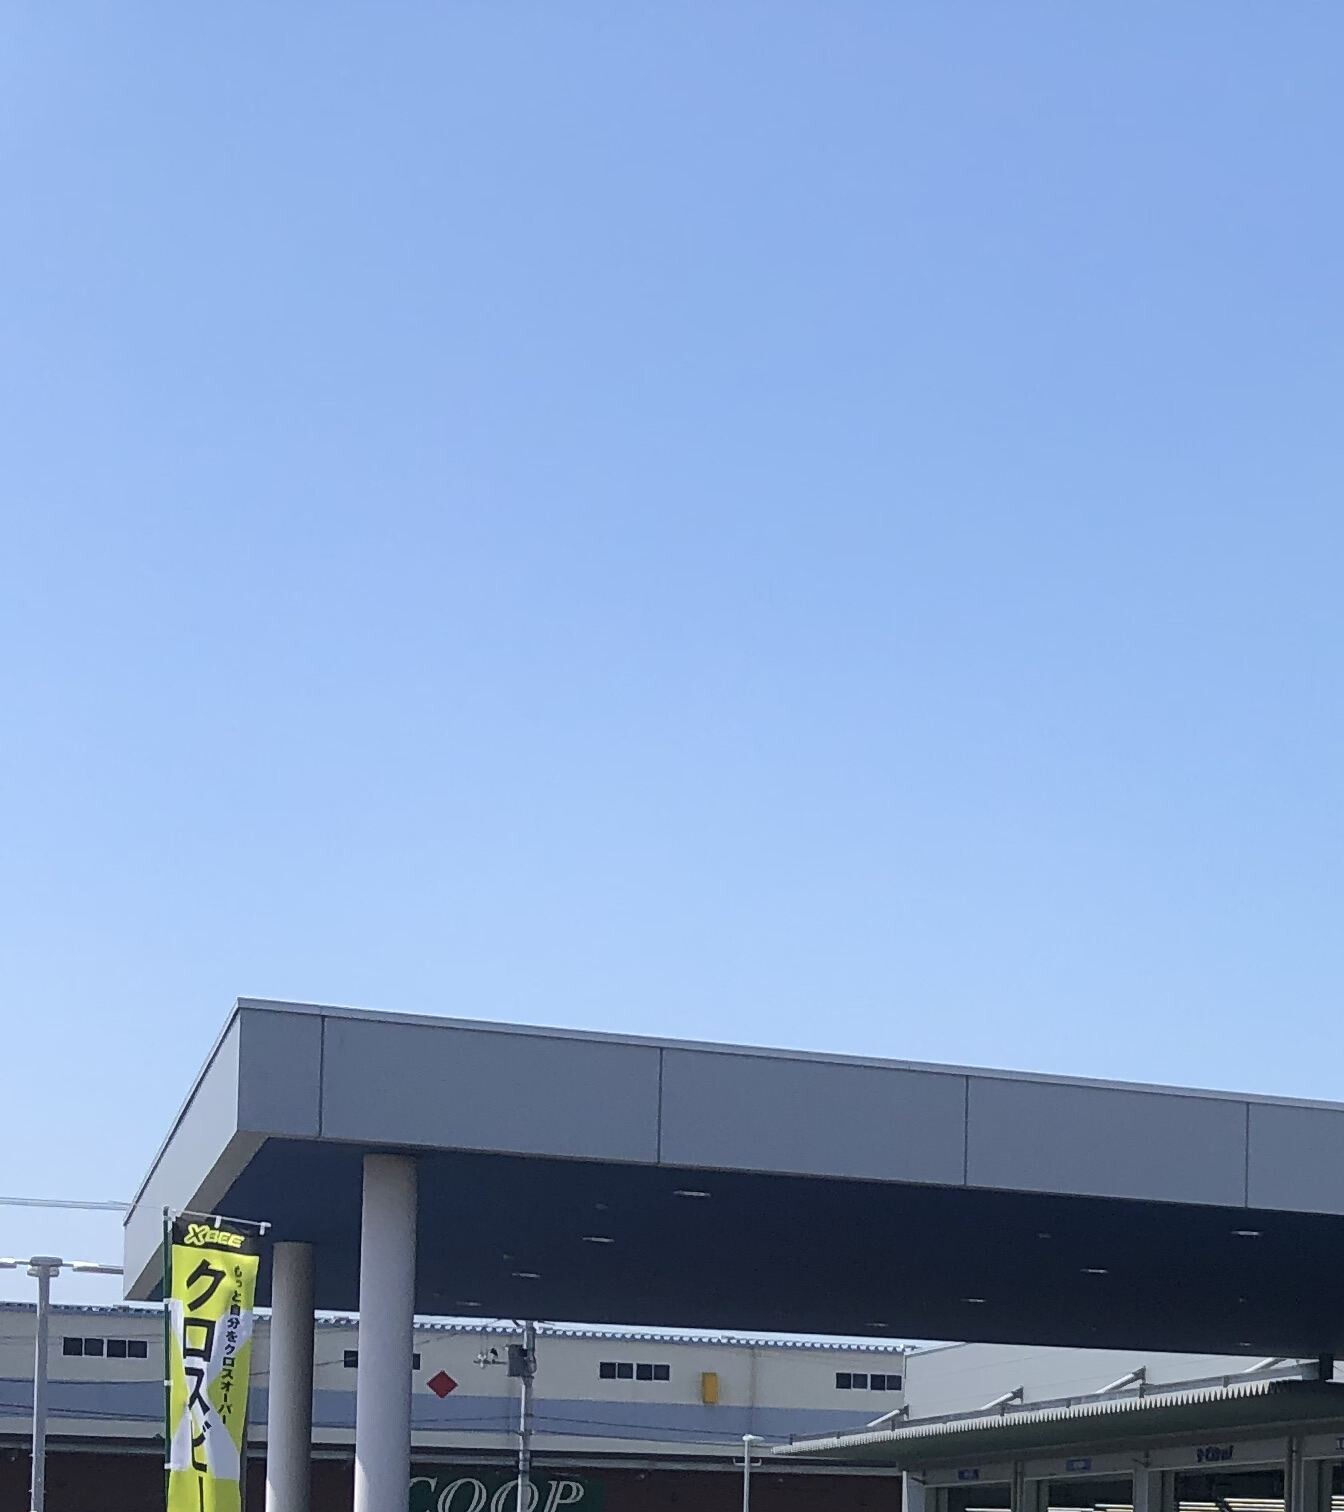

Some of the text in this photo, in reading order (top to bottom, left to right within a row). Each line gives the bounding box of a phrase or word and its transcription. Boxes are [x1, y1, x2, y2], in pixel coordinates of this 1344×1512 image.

[184, 1223, 246, 1249] XBEE
[217, 1264, 243, 1425] もっと自分をクロスオーバー
